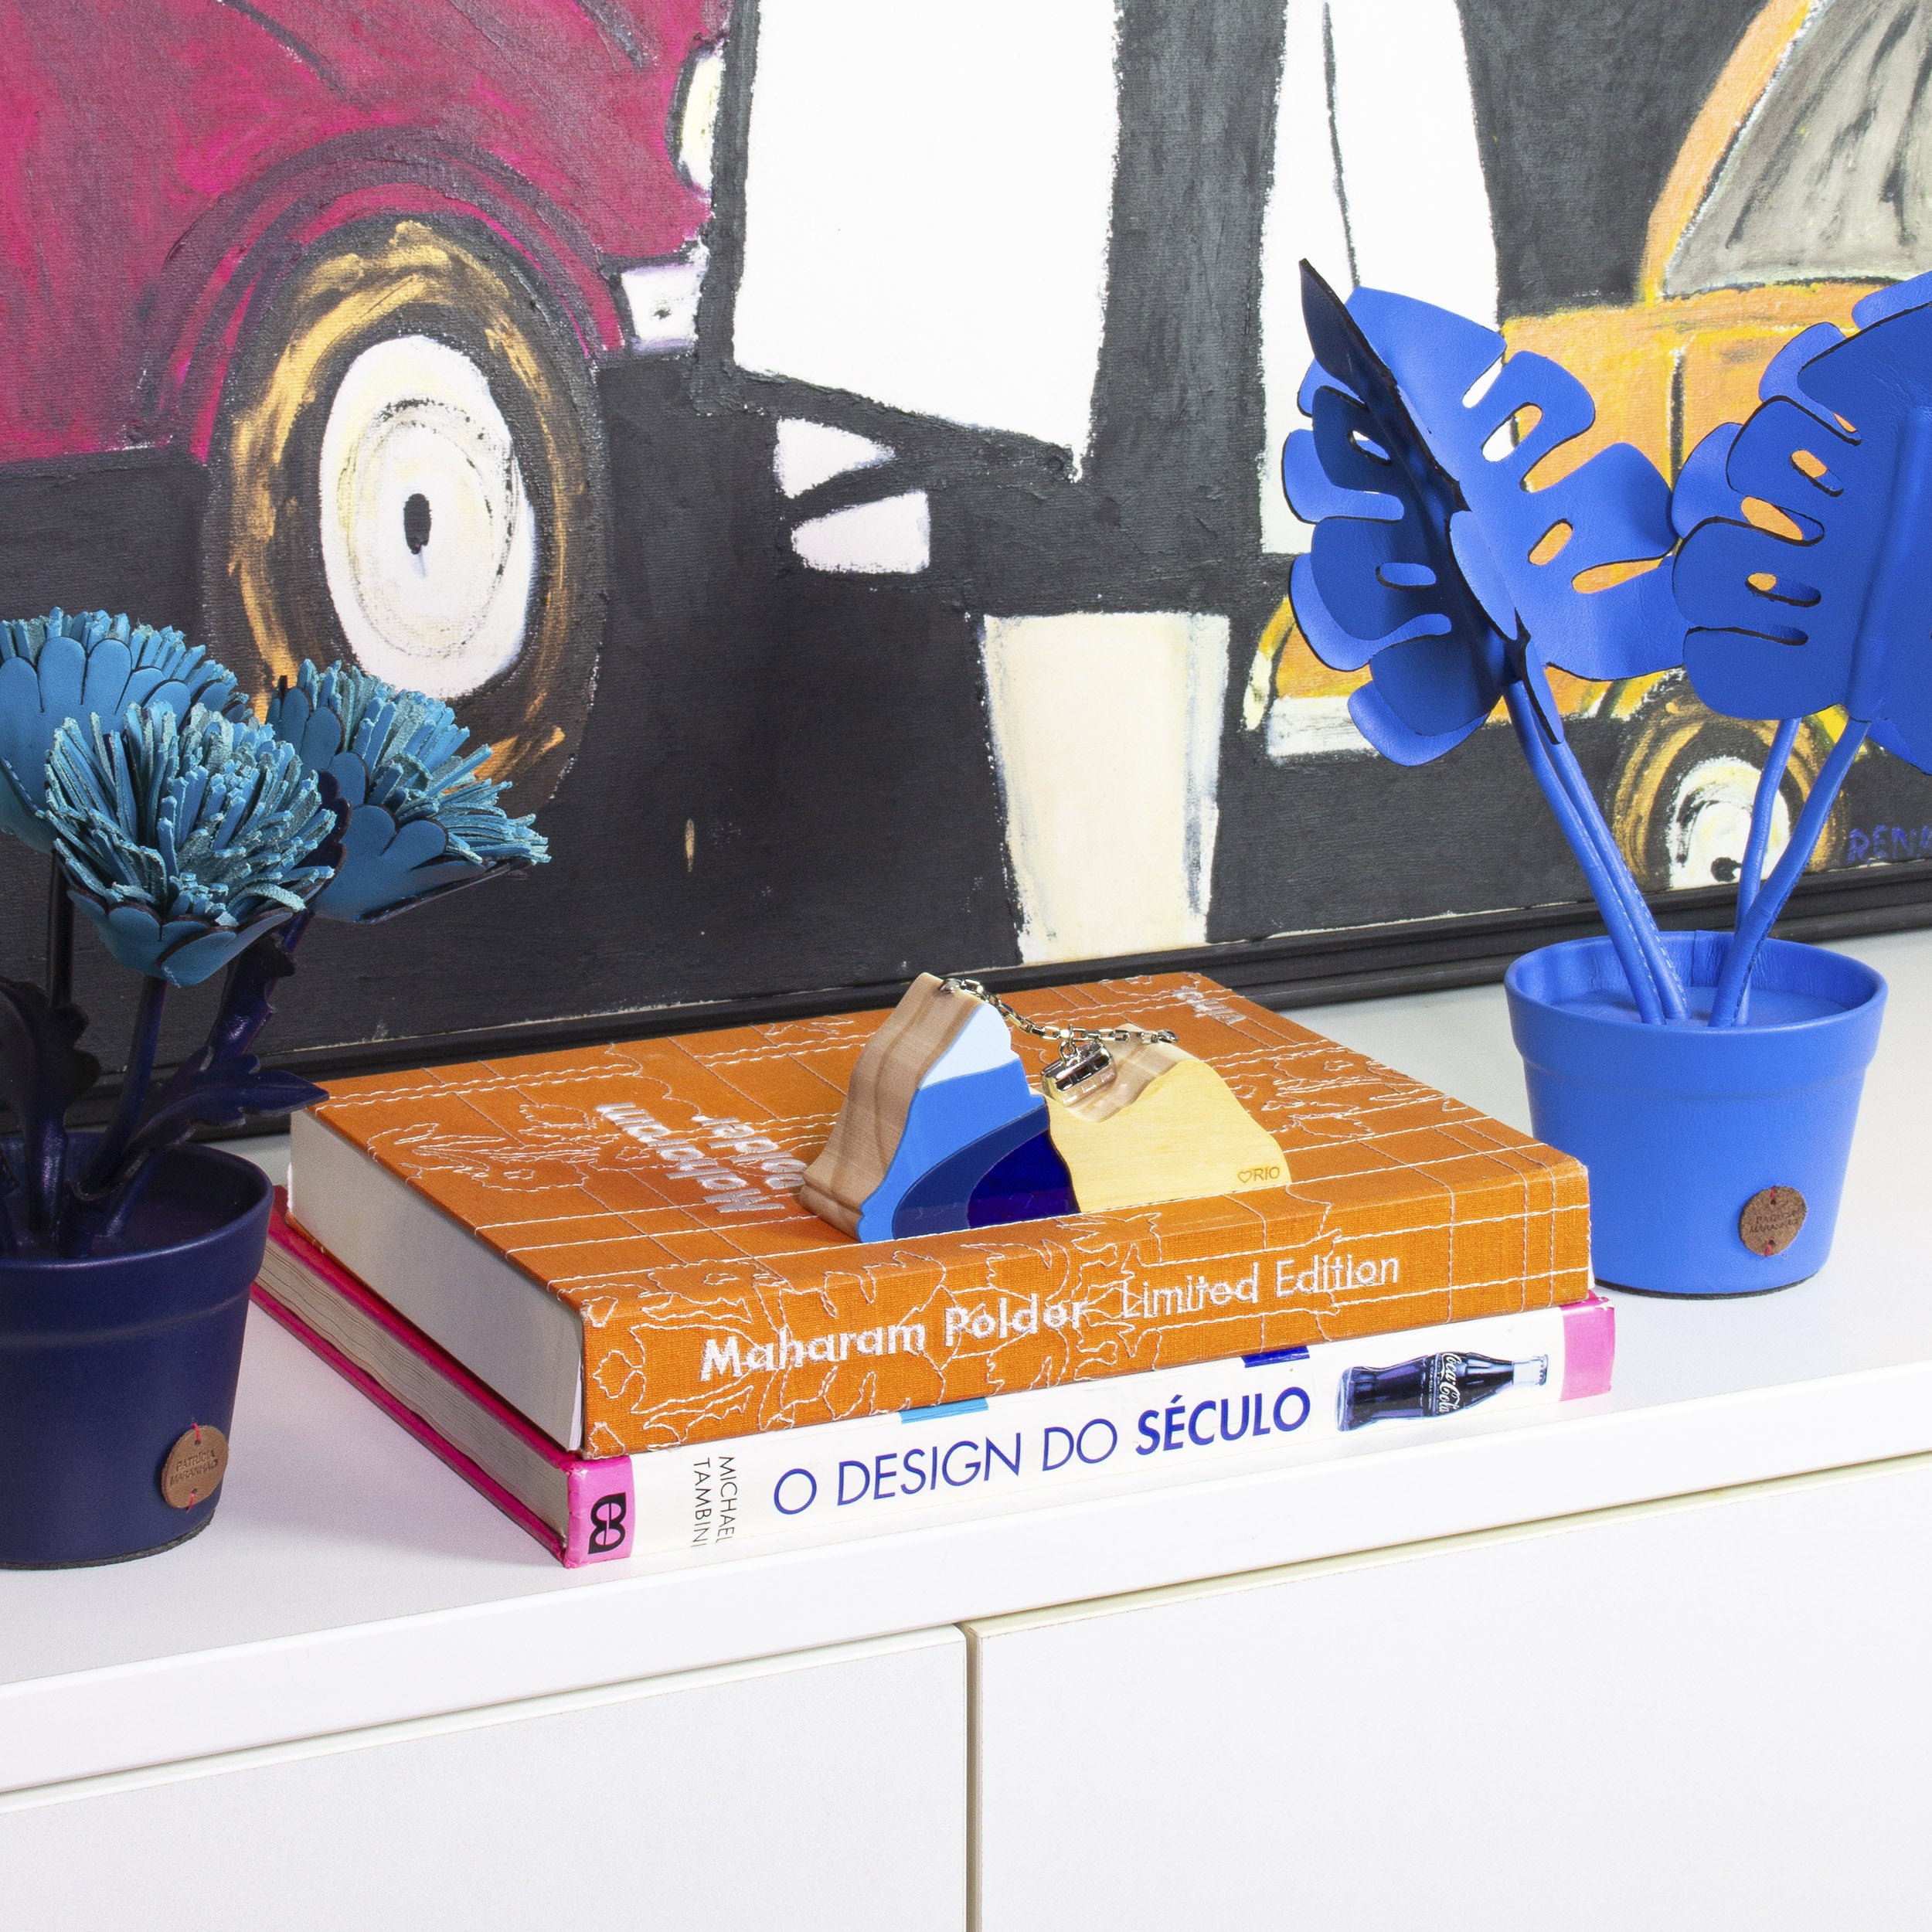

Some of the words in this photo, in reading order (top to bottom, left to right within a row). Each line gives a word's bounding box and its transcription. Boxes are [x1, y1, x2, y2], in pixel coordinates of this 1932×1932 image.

[595, 1101, 785, 1213] Maharam
[1253, 1165, 1281, 1182] RIO
[699, 1321, 927, 1382] Maharam
[944, 1292, 1084, 1347] Polder
[1121, 1261, 1260, 1319] Limited
[1275, 1253, 1400, 1298] Edition
[716, 1457, 738, 1543] MICHAEL
[774, 1468, 817, 1515] O
[837, 1432, 1022, 1507] DESIGN
[1042, 1418, 1118, 1471] DO
[1134, 1386, 1311, 1456] SÉCULO
[692, 1458, 712, 1547] TAMBINI
